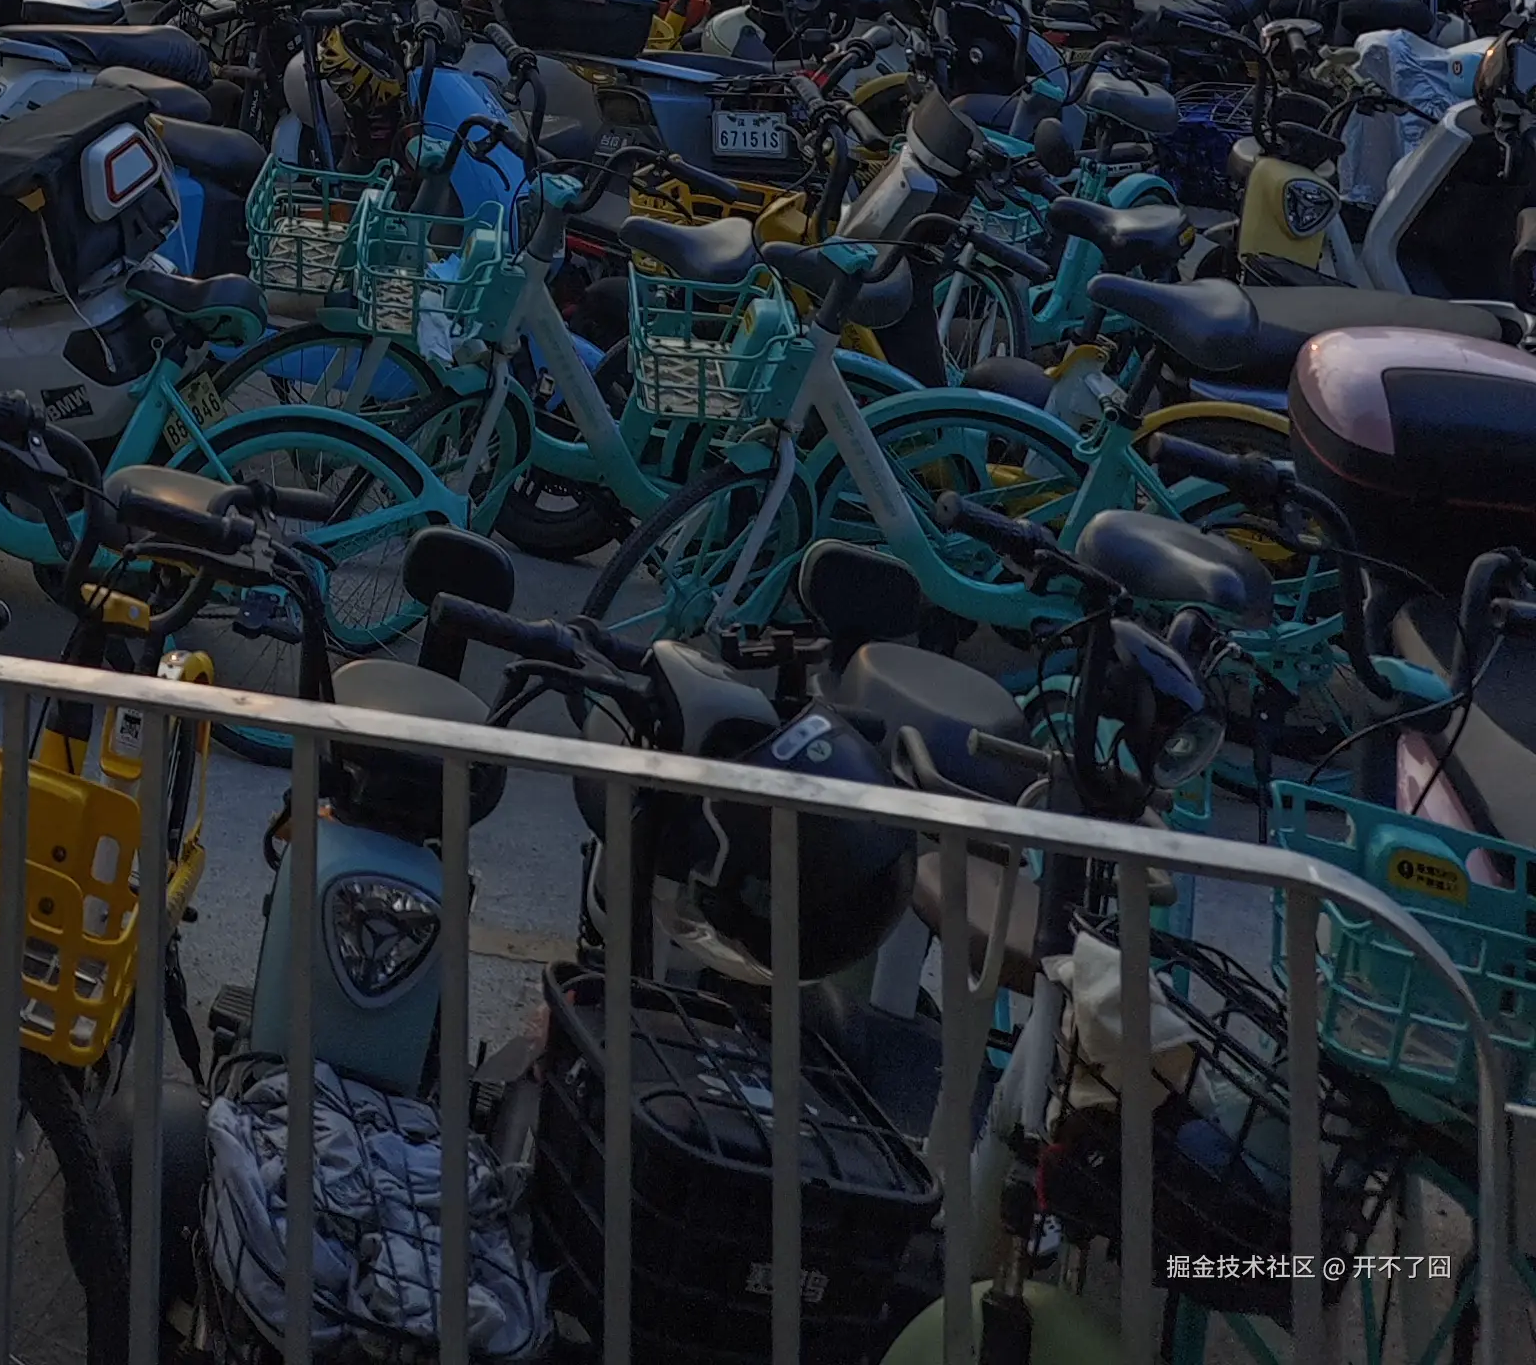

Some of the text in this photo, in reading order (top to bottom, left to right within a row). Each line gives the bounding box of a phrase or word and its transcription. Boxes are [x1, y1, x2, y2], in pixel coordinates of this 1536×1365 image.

[720, 129, 778, 148] 67151S
[46, 384, 91, 420] BMW
[166, 393, 220, 446] B5846
